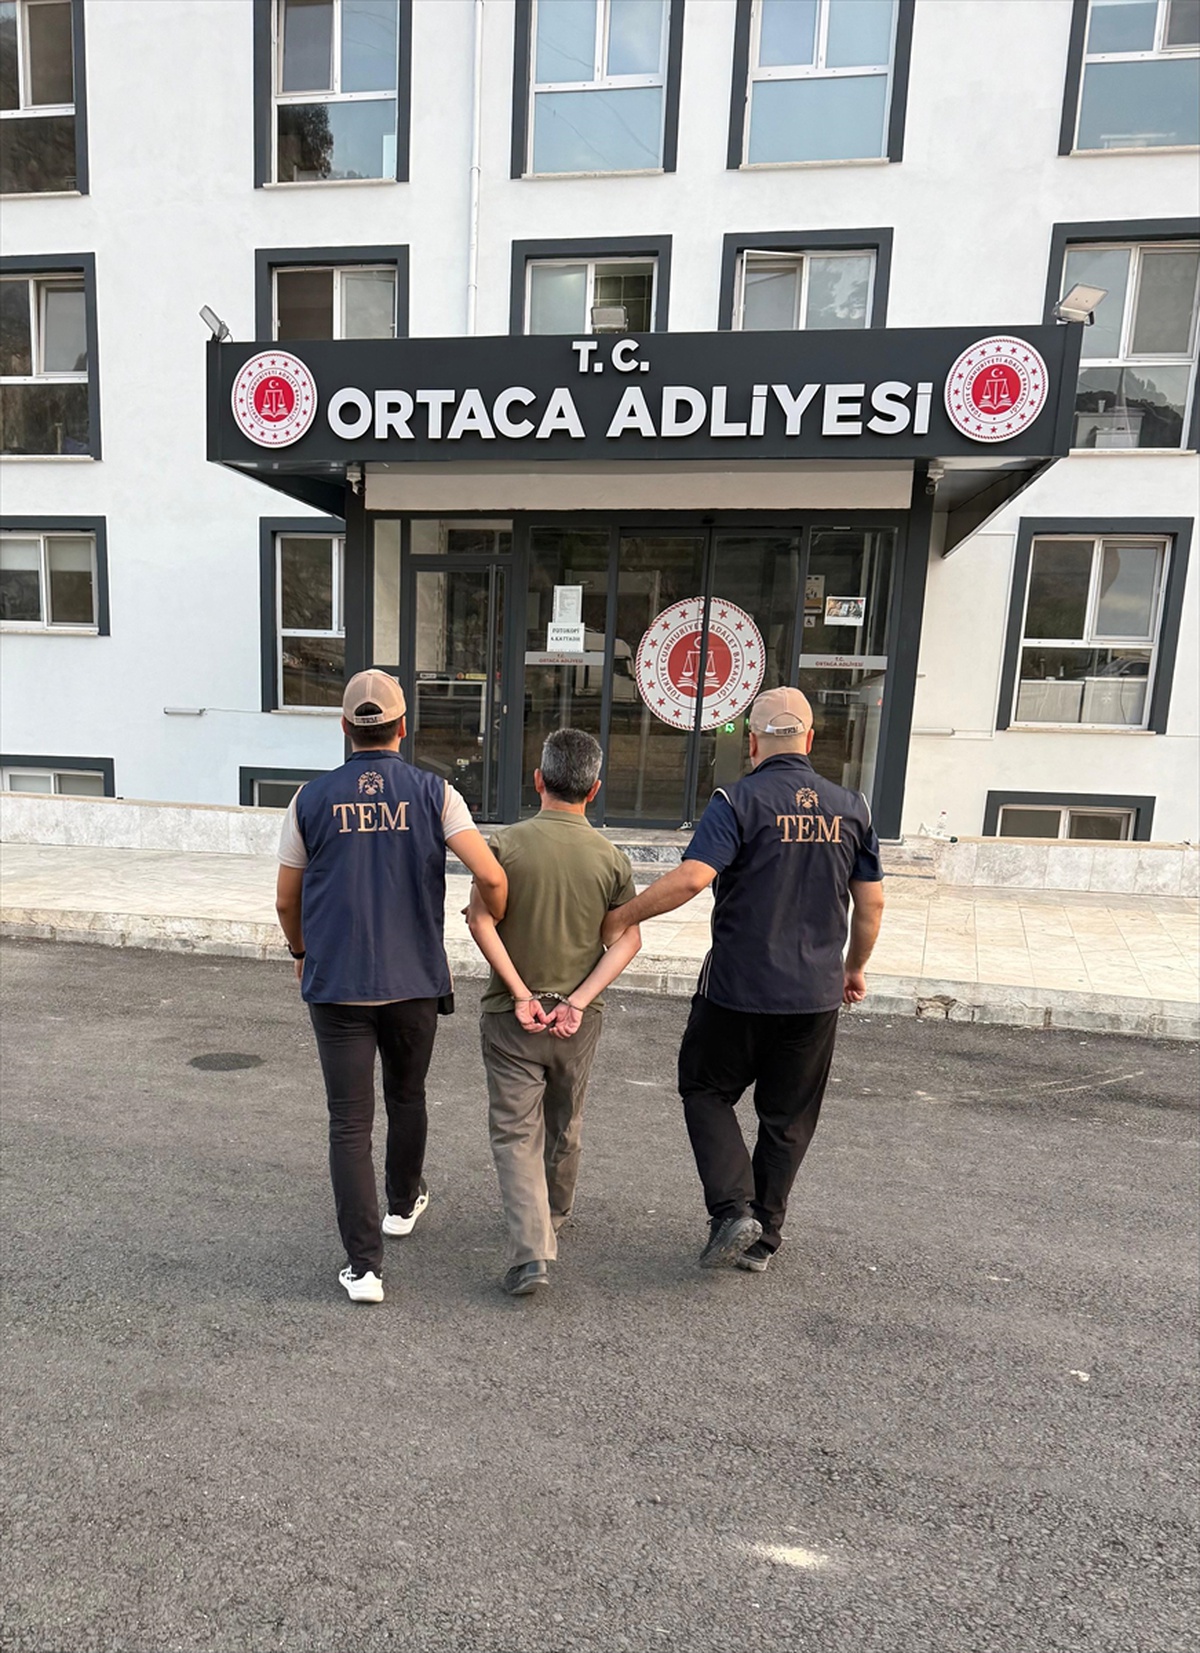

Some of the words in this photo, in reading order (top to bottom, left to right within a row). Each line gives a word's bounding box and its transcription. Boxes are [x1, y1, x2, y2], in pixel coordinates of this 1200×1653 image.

[572, 341, 604, 373] T.
[611, 339, 650, 373] C.
[327, 387, 586, 440] ORTACA
[606, 381, 934, 438] ADLİYESİ
[710, 624, 738, 651] ADALET
[332, 801, 410, 833] TEM
[776, 815, 843, 843] TEM
